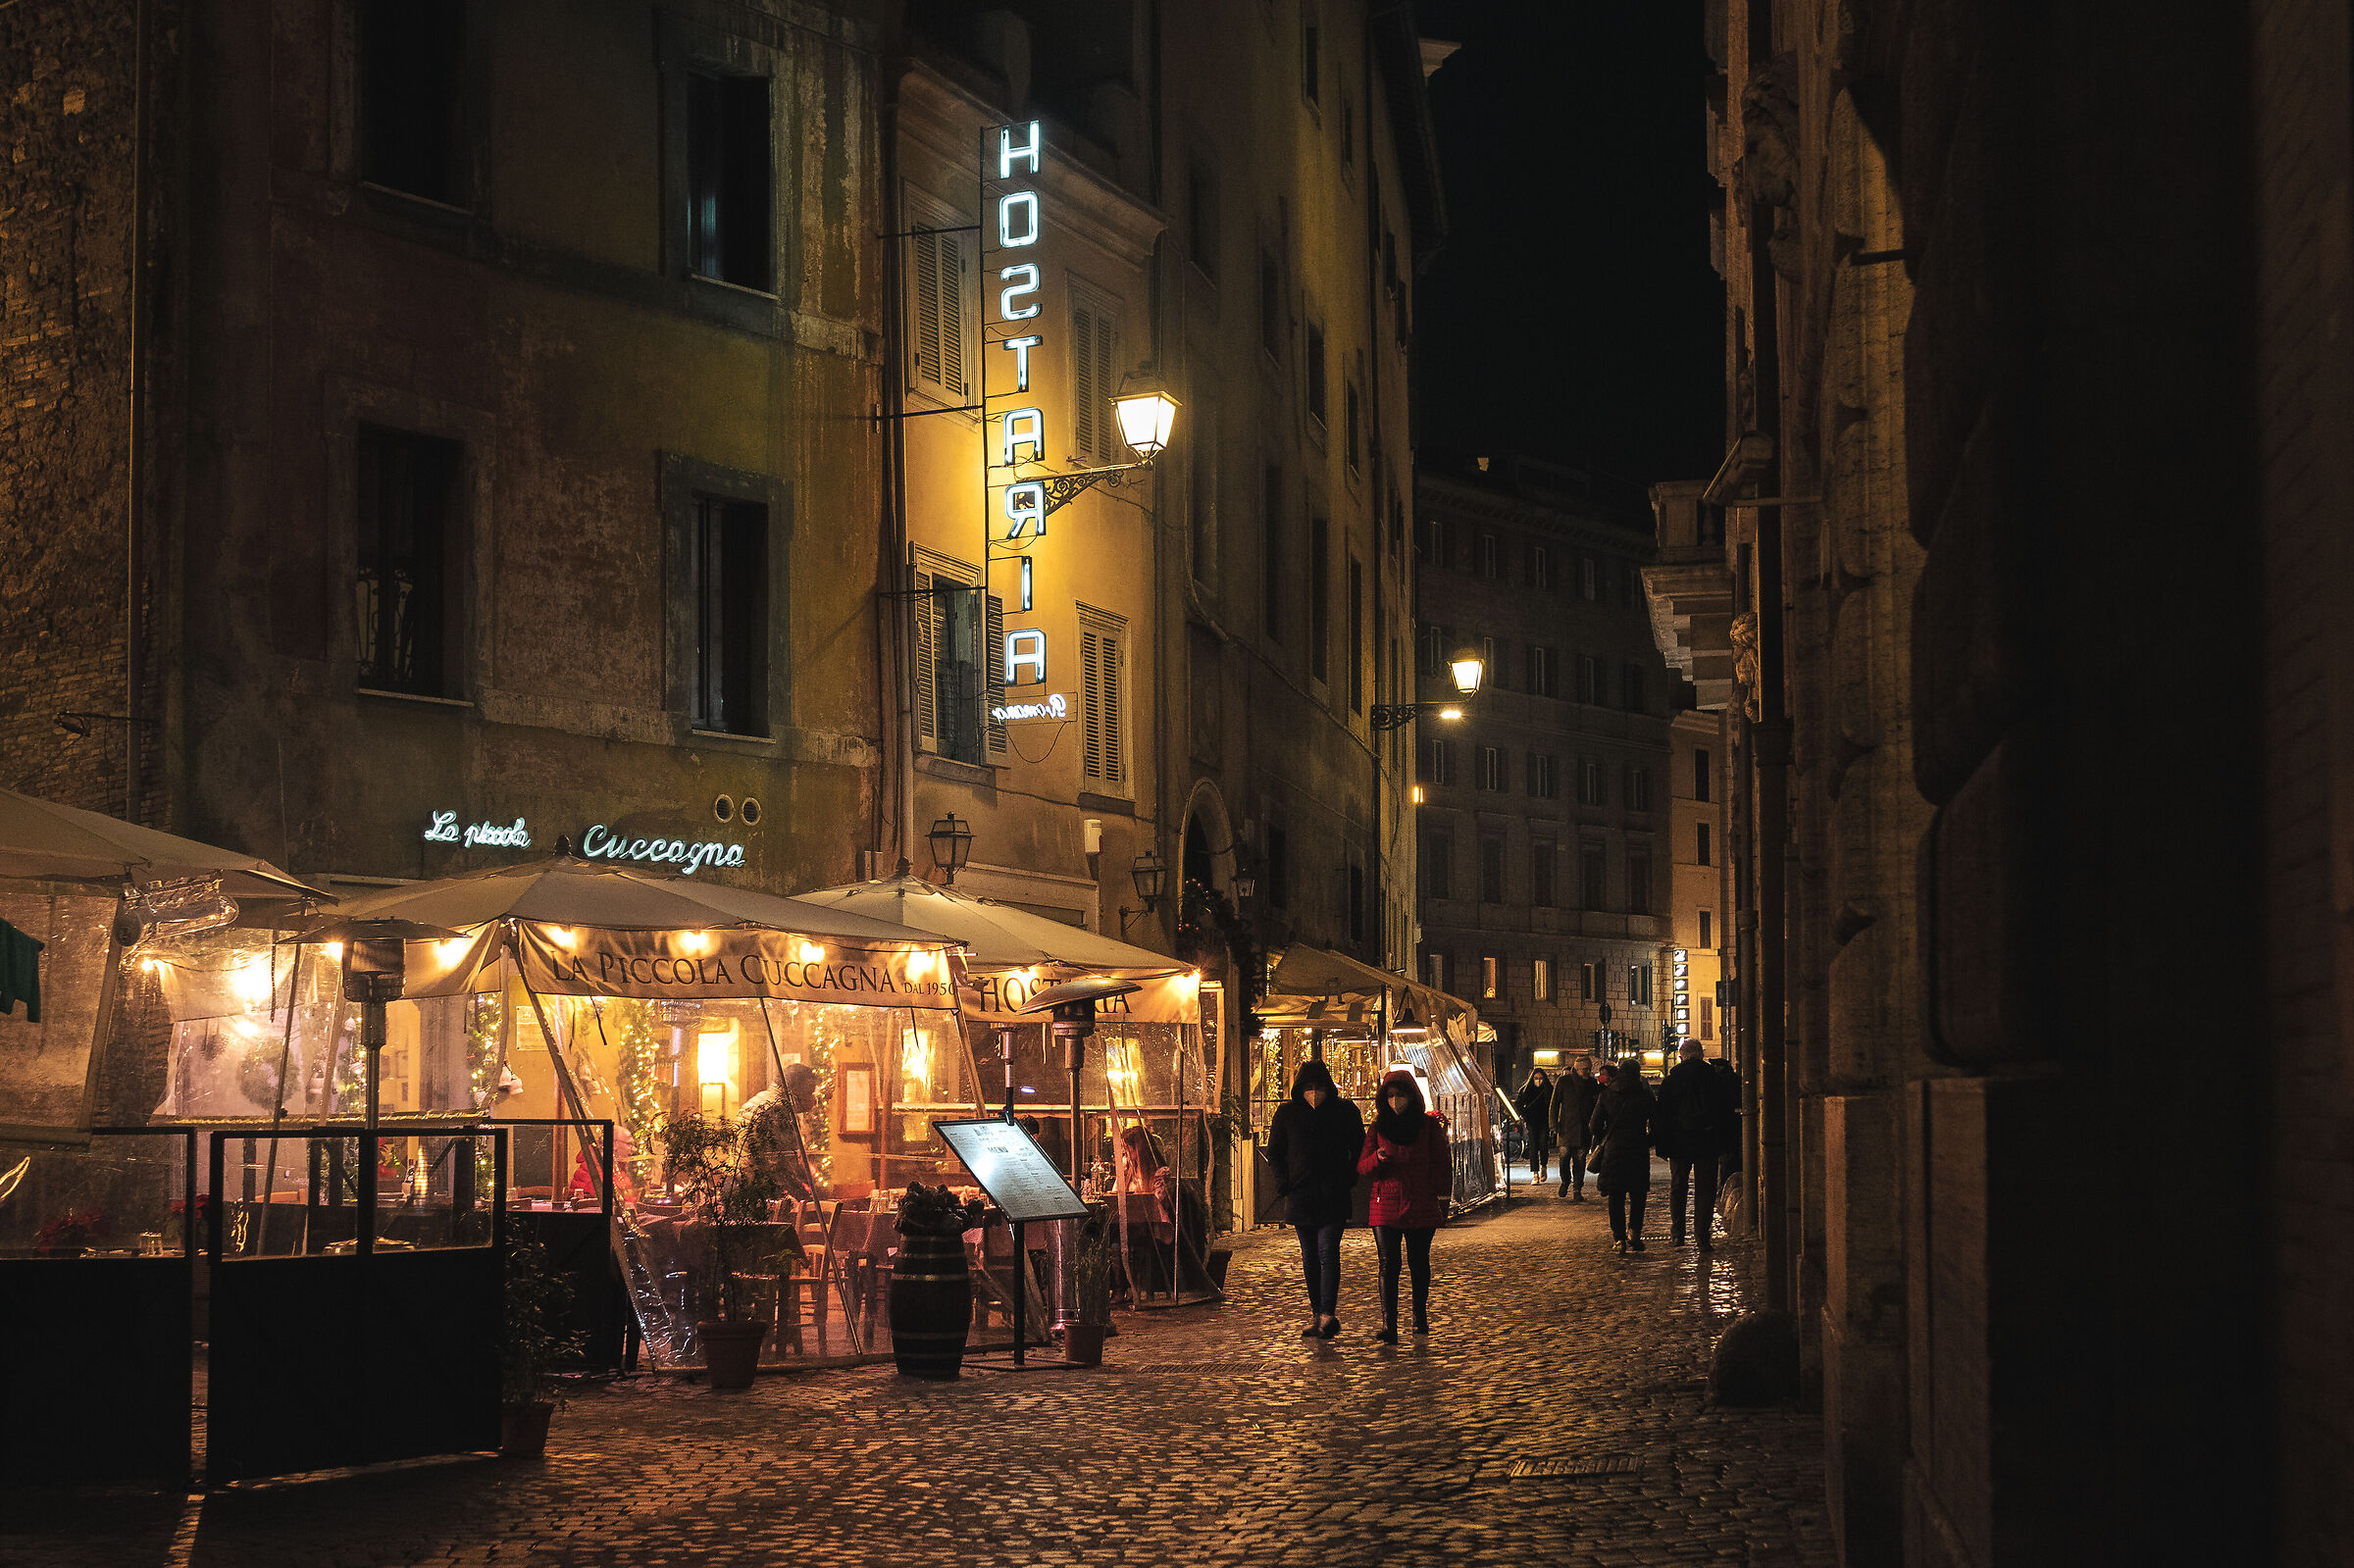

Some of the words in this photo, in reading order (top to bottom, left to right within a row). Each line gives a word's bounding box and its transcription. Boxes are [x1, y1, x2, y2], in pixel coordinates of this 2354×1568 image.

[425, 810, 459, 840] La
[464, 817, 531, 848] piccola
[583, 824, 745, 875] Cuccagna
[551, 950, 591, 982] LA
[597, 951, 736, 985] PICCOLA
[740, 954, 896, 993] CUCCAGNA
[902, 982, 924, 994] DAL
